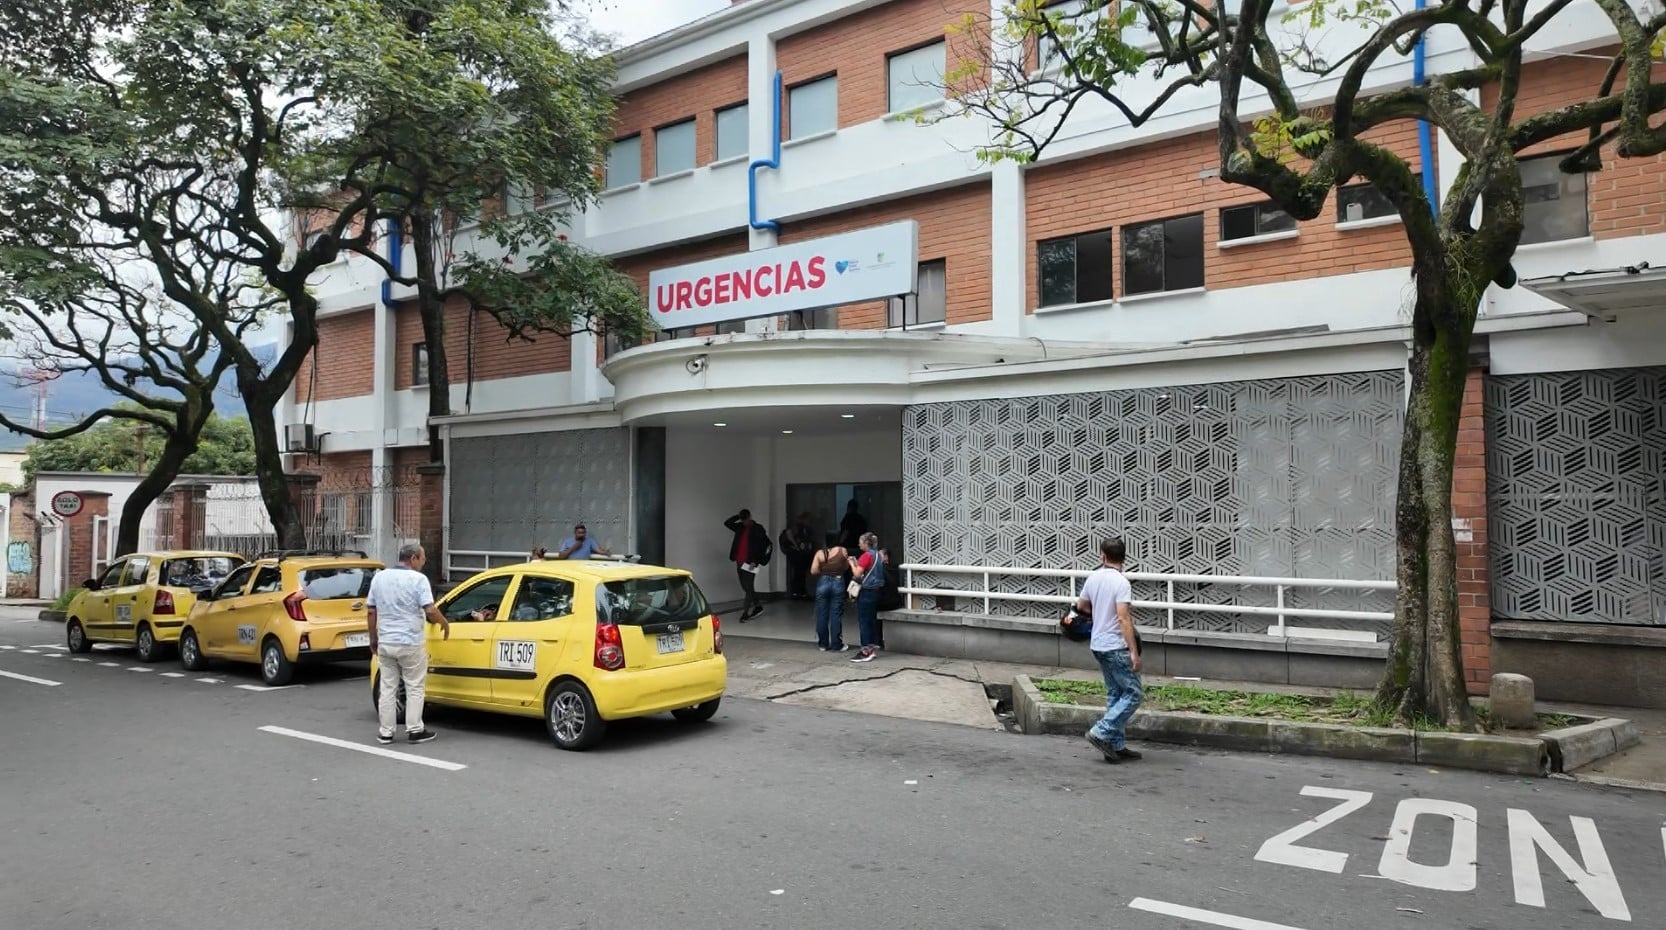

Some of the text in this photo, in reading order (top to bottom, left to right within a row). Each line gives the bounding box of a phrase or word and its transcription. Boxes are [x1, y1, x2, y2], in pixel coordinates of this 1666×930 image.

[656, 255, 826, 313] URGENCIAS
[500, 642, 533, 664] TRI 509
[1253, 785, 1666, 922] ZON
